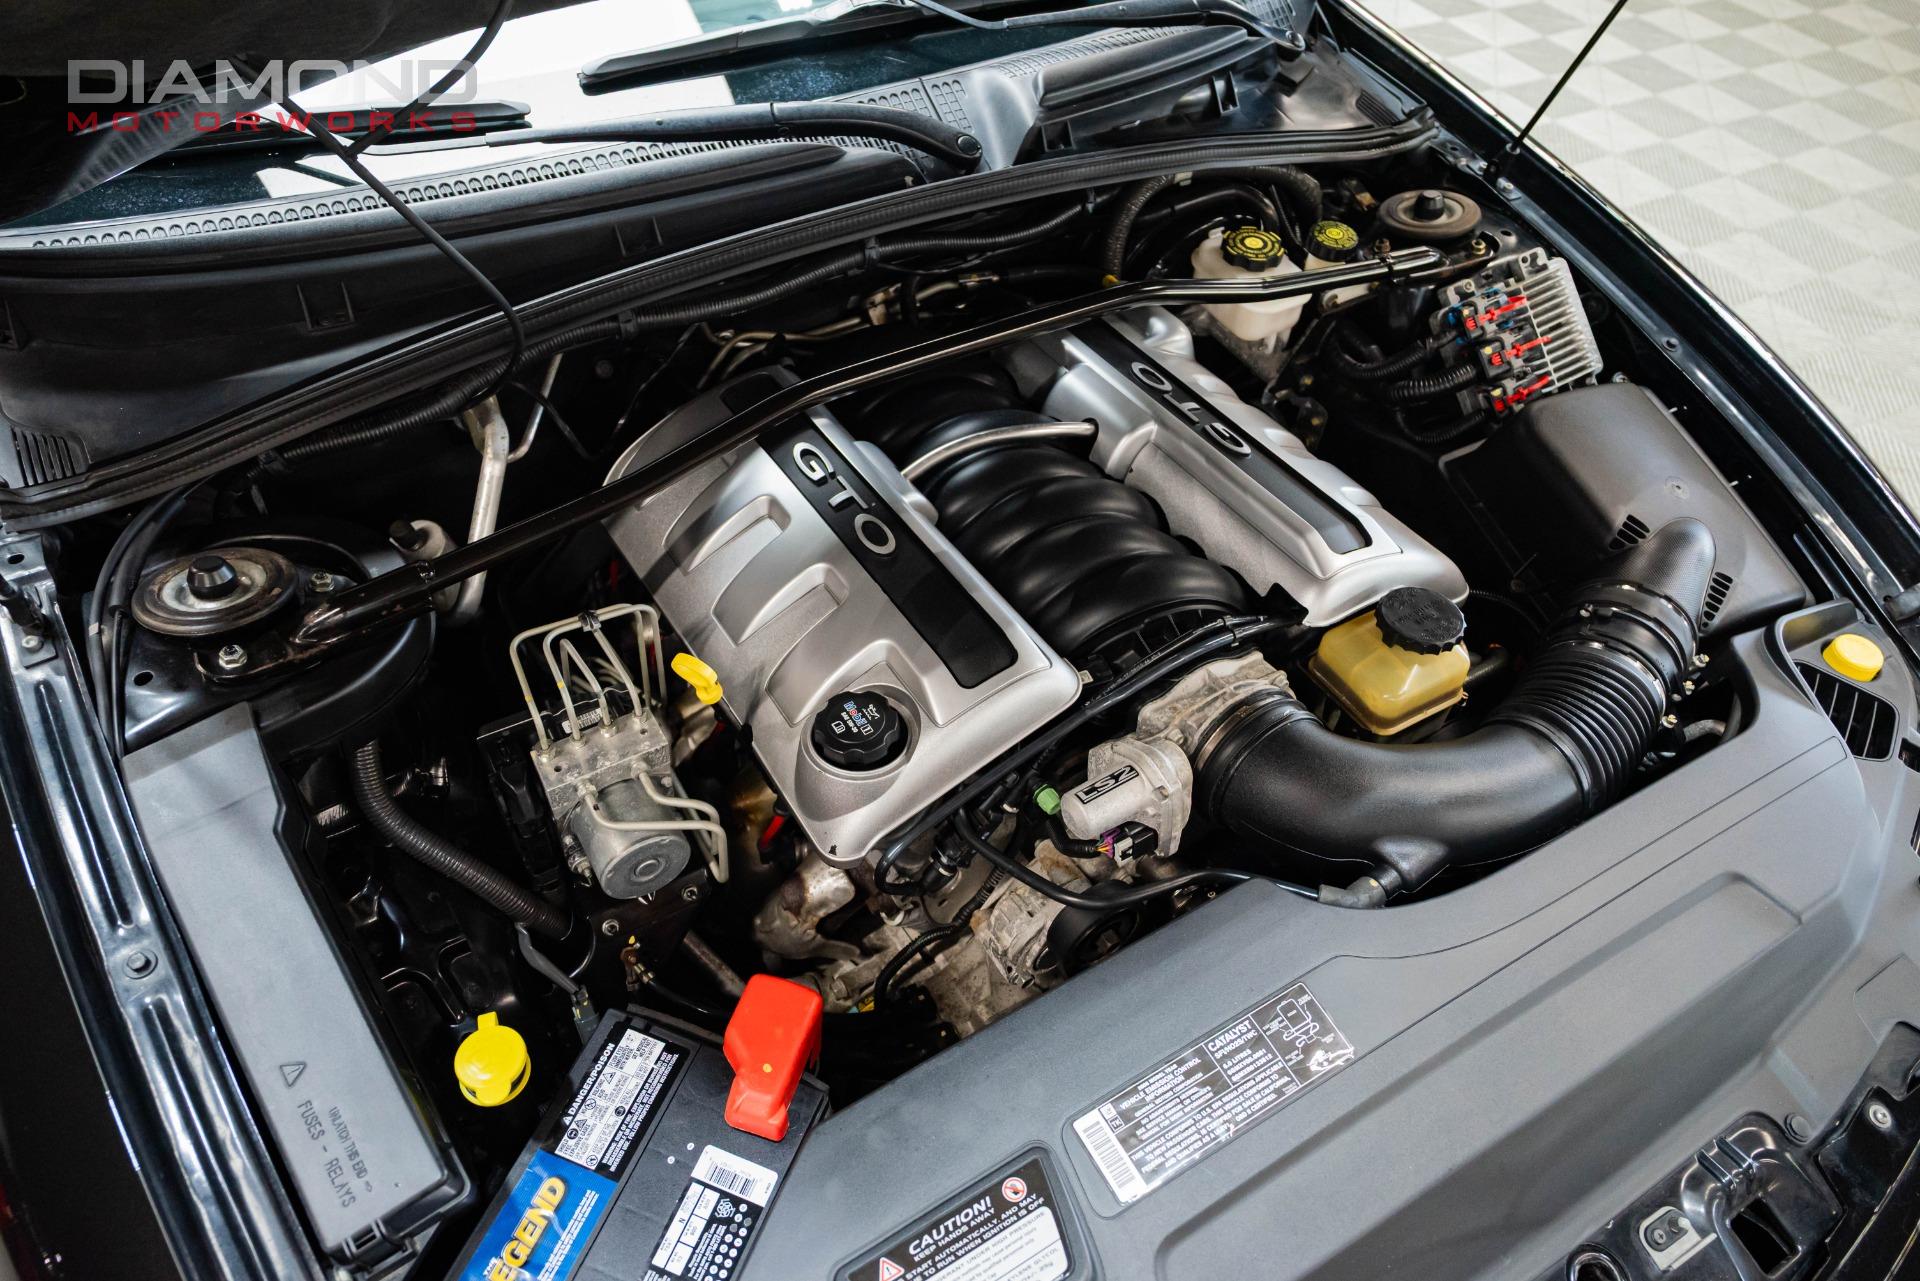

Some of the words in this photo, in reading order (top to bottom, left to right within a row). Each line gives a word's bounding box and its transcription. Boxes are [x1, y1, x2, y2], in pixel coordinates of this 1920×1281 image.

[1131, 361, 1251, 455] GTO
[793, 441, 896, 555] GTO
[843, 700, 867, 727] Mobil
[1076, 765, 1139, 803] LS2
[1207, 1019, 1252, 1052] CATALYST
[1231, 1048, 1252, 1064] LITRES
[567, 1040, 615, 1117] DANGER/POISON
[1119, 1090, 1146, 1110] VEHICLE
[1144, 1072, 1174, 1095] EMISSION
[1173, 1056, 1201, 1077] CONTROL
[1144, 1074, 1185, 1102] INFORMATION
[1269, 1072, 1279, 1082] TO
[329, 1106, 352, 1143] UNLATCH
[1110, 1118, 1122, 1128] TK
[1143, 1136, 1166, 1153] VEHICLE
[1193, 1113, 1202, 1121] TO
[1200, 1106, 1212, 1117] U.S.
[1211, 1099, 1223, 1110] EPA
[297, 1100, 325, 1141] FUSES
[324, 1158, 356, 1207] RELAYS
[344, 1141, 360, 1161] THIS
[351, 1159, 369, 1179] END
[488, 1176, 567, 1281] EGEND
[904, 1259, 933, 1280] START
[999, 1205, 1018, 1220] AND
[1017, 1193, 1037, 1208] MAY
[908, 1196, 992, 1255] CAUTION!
[912, 1243, 938, 1262] KEEP
[936, 1224, 969, 1246] HANDS
[968, 1207, 996, 1227] AWAY
[922, 1266, 936, 1277] TO
[935, 1254, 955, 1269] RUN
[954, 1237, 982, 1257] WHEN
[981, 1214, 1018, 1240] IGNITION
[1017, 1207, 1027, 1217] IS
[1026, 1196, 1045, 1211] OFF
